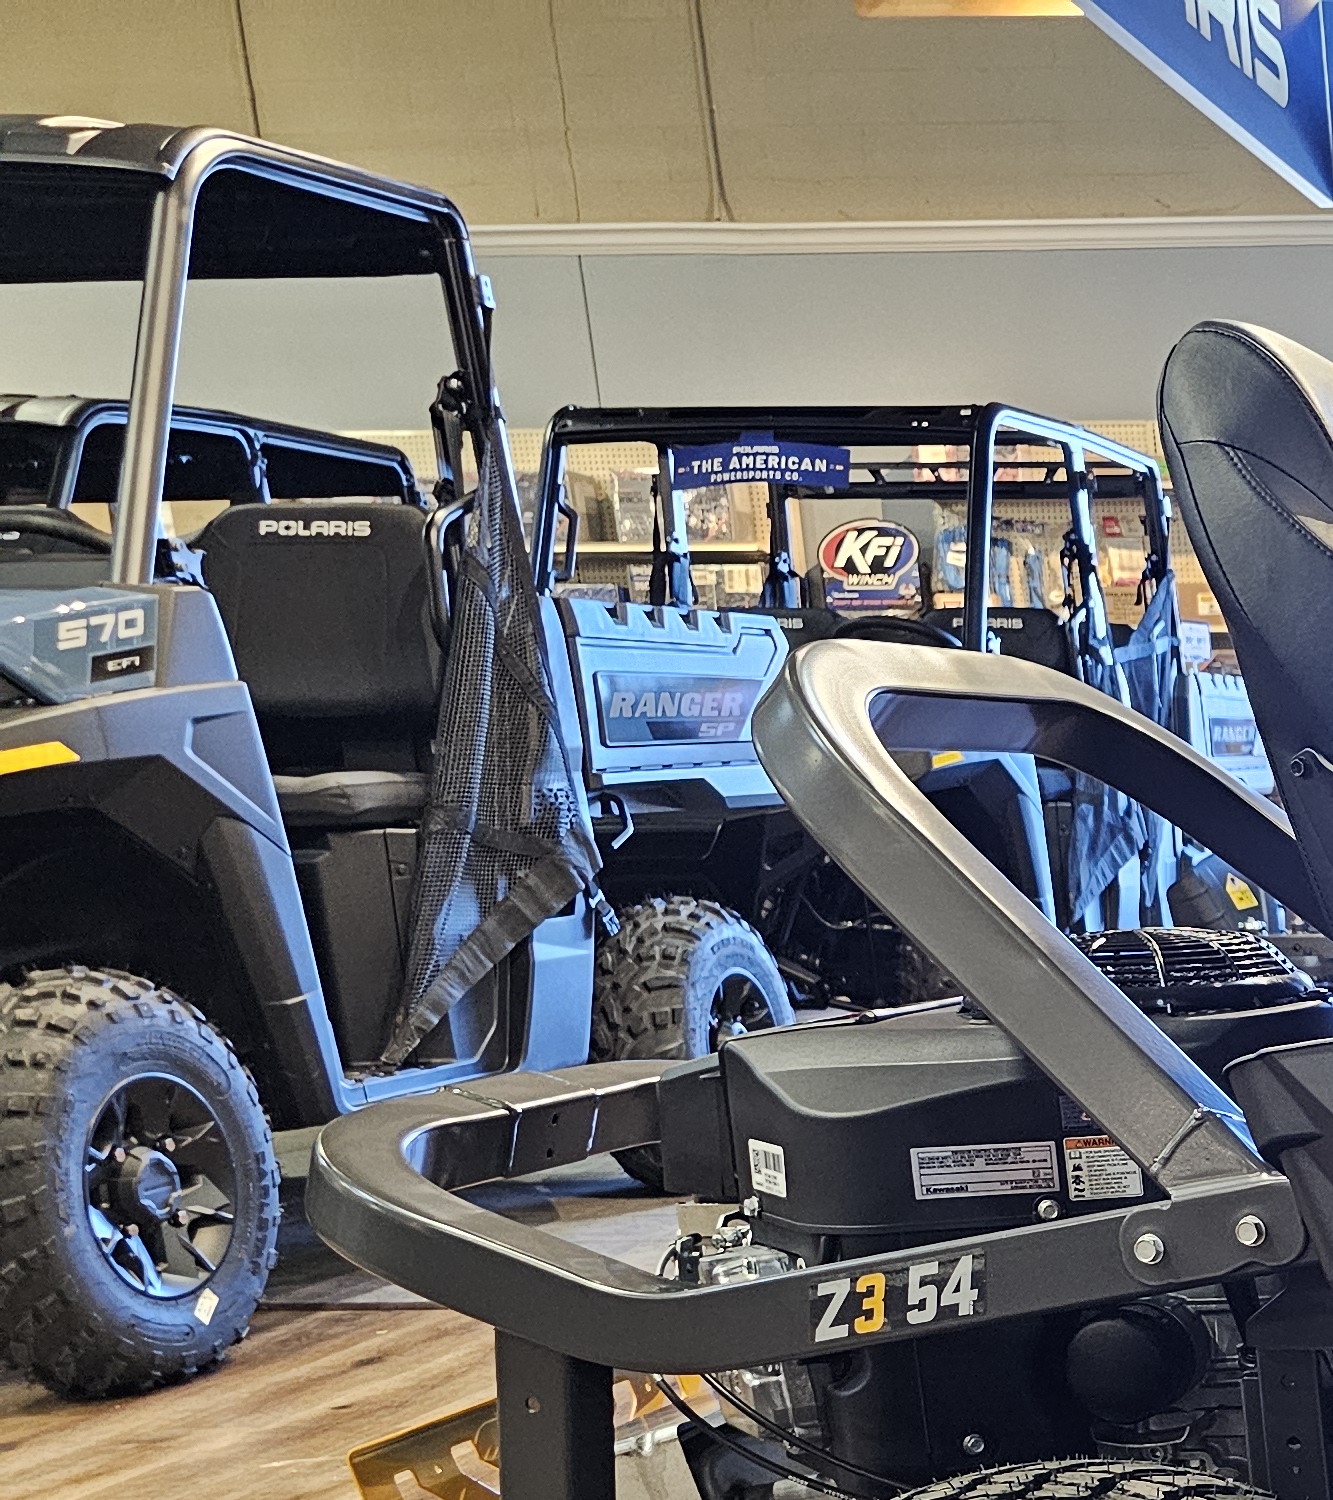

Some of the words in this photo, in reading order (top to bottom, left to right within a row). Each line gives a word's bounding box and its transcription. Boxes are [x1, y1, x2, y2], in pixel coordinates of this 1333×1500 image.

[733, 446, 779, 454] POLARIS
[692, 457, 723, 475] THE
[729, 455, 828, 473] AMERICAN
[711, 471, 781, 482] POWERSPORTS
[258, 520, 372, 537] POLARIS
[848, 573, 894, 586] WINCH
[57, 608, 145, 651] 570
[952, 617, 1023, 629] PARIS
[609, 692, 743, 718] RANGER
[699, 722, 737, 737] SP
[1083, 1138, 1117, 1147] WARN
[925, 1184, 969, 1194] Kawasaki
[815, 1272, 886, 1343] Z3
[906, 1254, 979, 1325] 54
